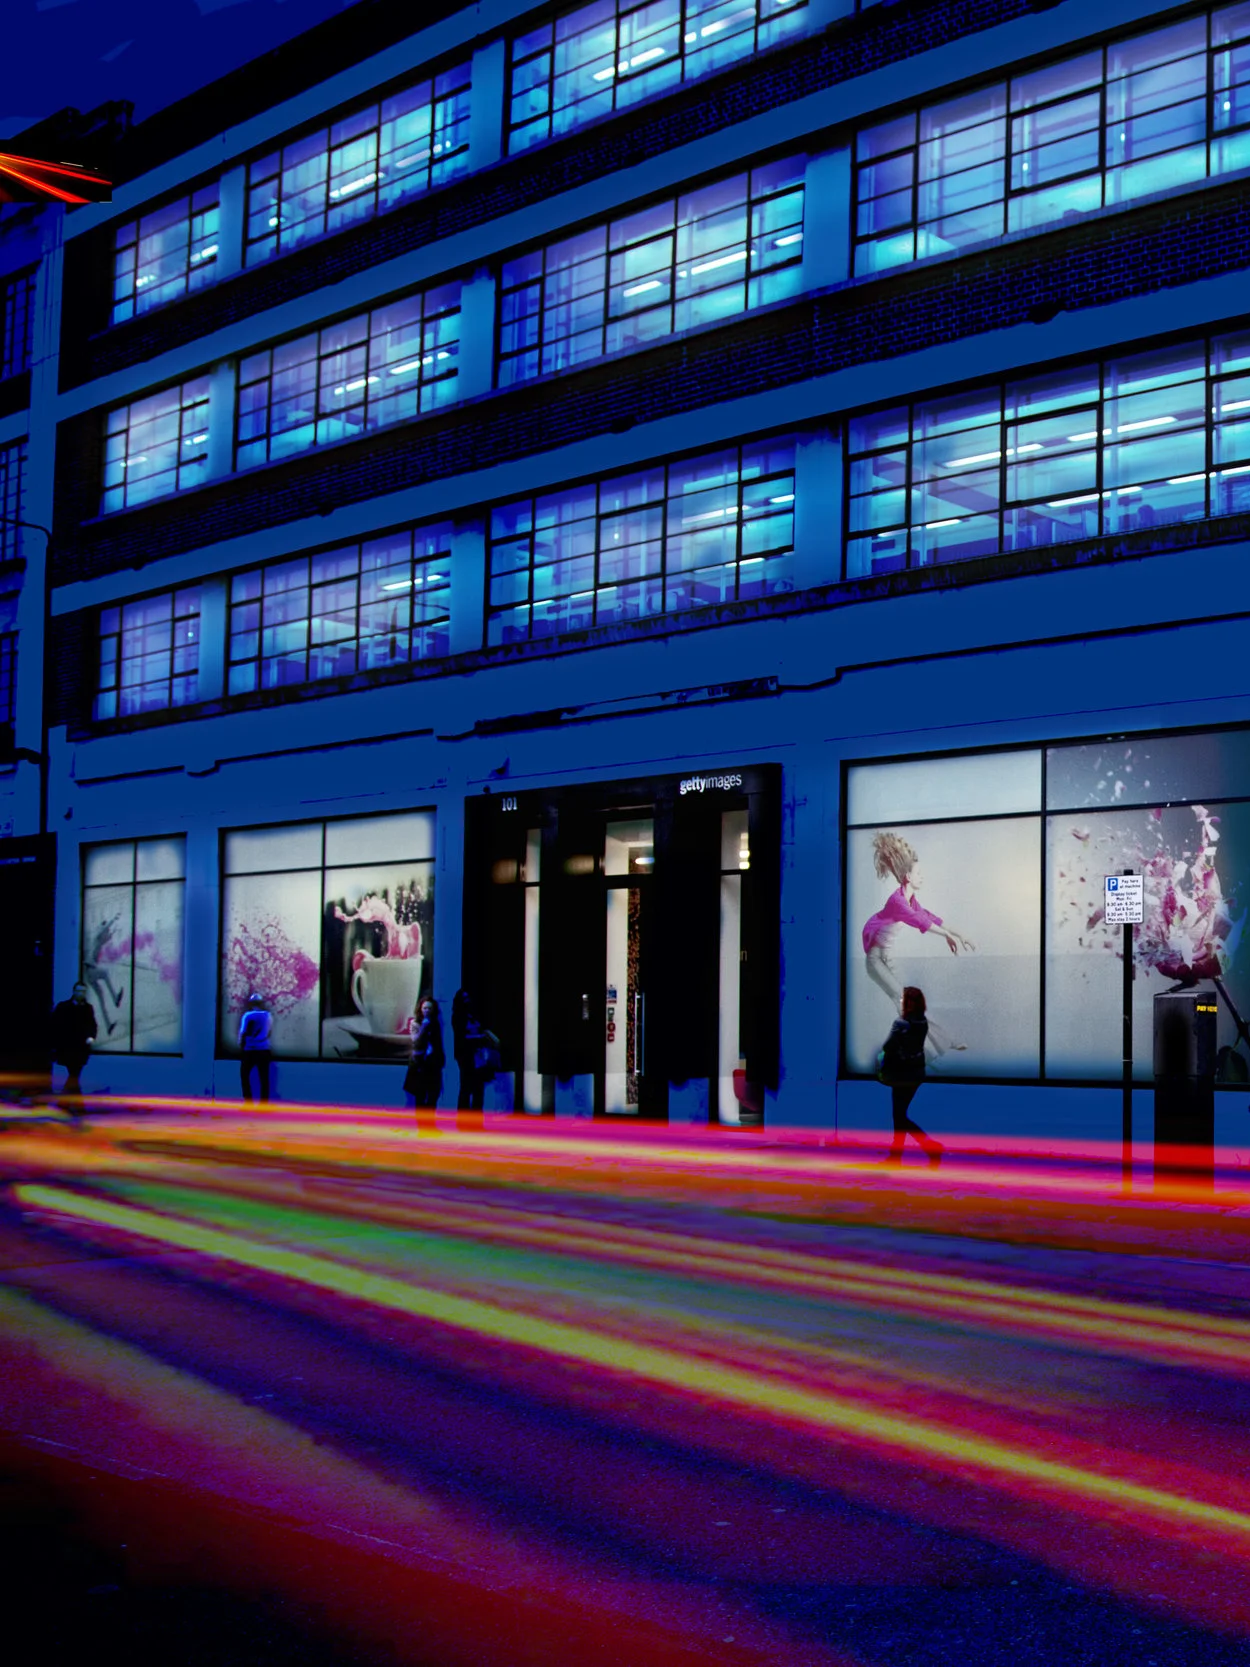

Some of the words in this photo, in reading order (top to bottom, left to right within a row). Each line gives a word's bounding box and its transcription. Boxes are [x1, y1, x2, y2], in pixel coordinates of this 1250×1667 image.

[680, 774, 742, 795] gettyimages
[502, 797, 517, 811] 101
[1110, 879, 1117, 890] P
